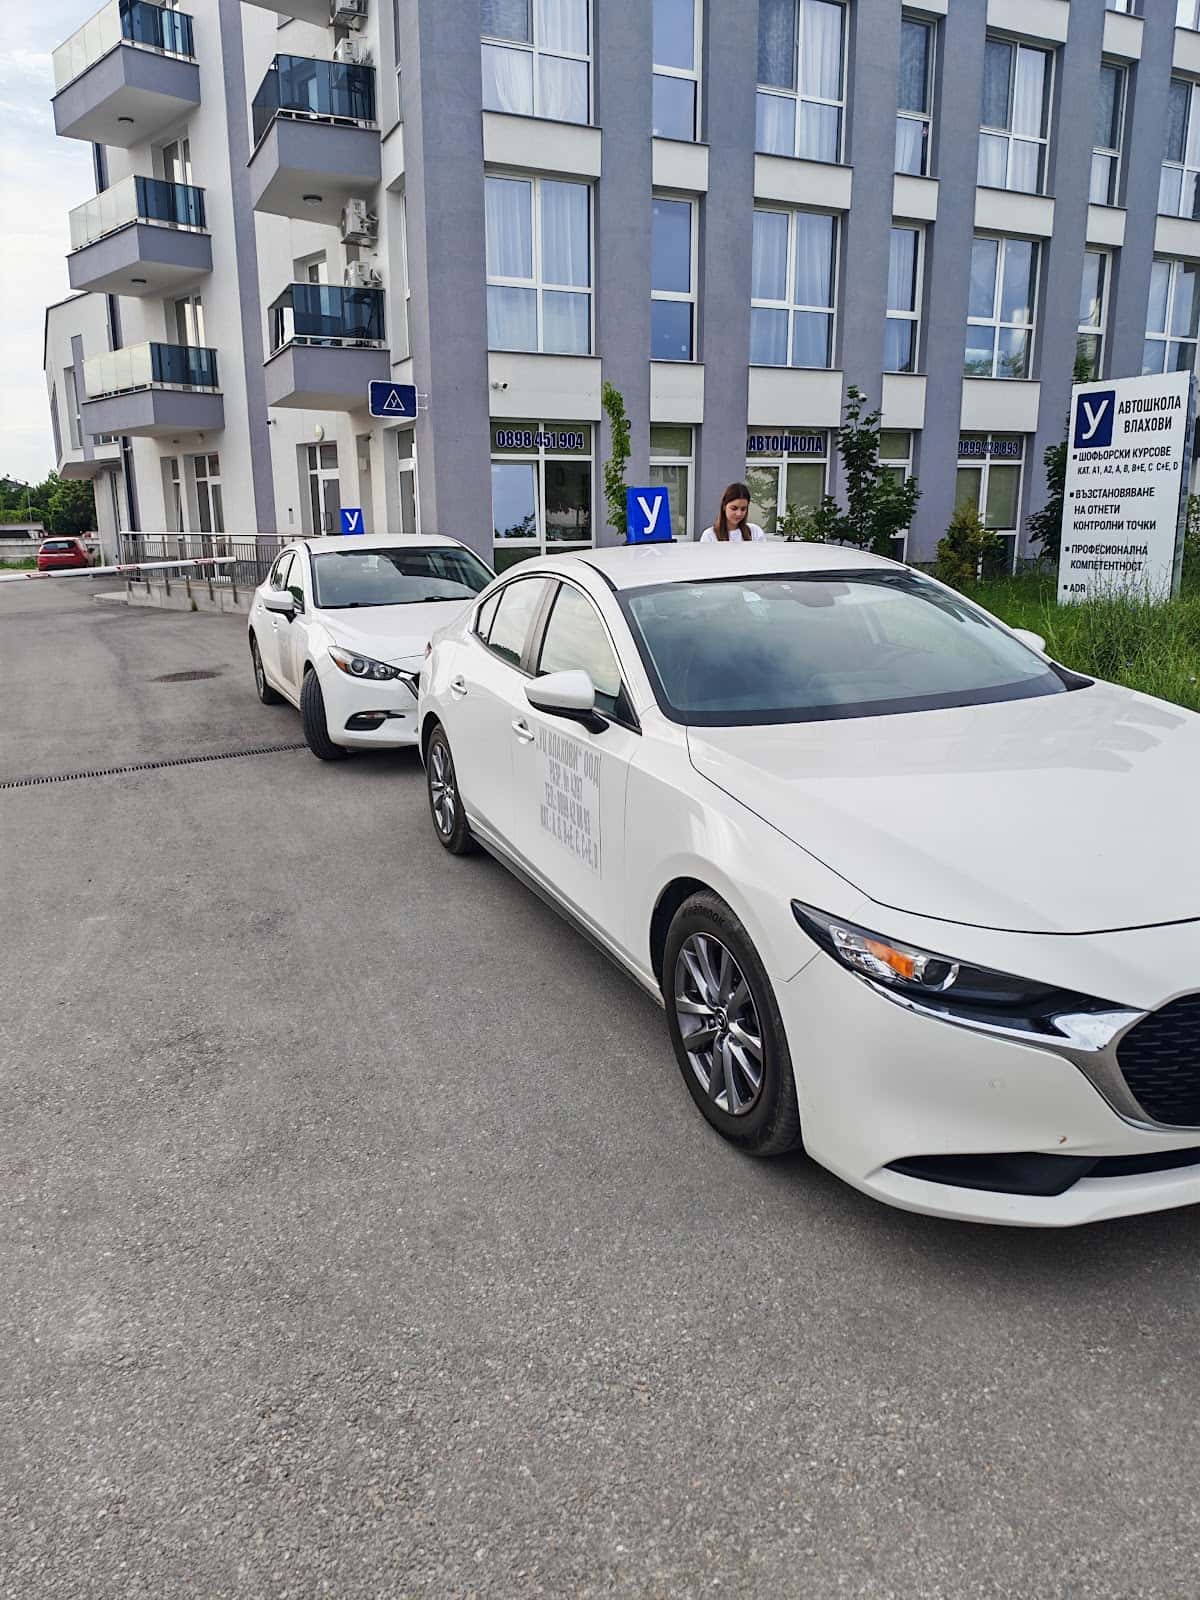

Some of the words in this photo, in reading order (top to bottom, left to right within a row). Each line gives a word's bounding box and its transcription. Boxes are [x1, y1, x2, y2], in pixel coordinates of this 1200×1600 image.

[1118, 396, 1181, 415] АВТОШКОЛА
[1082, 400, 1109, 440] У
[1124, 416, 1172, 433] ВЛАХОВИ
[496, 430, 532, 448] 0898
[534, 431, 558, 449] 451
[559, 432, 584, 449] 904
[748, 435, 823, 452] АВТОШКОЛА
[1001, 441, 1019, 455] 893
[1078, 448, 1130, 461] ШОФЬОРСКИ
[1132, 446, 1172, 459] КУРСОВЕ
[1173, 461, 1179, 470] D
[1075, 487, 1155, 499] ВЪЗСТАНОВЯВАНЕ
[637, 495, 662, 535] У
[1074, 505, 1085, 514] НА
[1088, 504, 1120, 514] ОТНЕТИ
[345, 511, 359, 531] У
[1073, 521, 1124, 530] КОНТРОЛНИ
[1126, 521, 1156, 530] ТОЧКИ
[1071, 545, 1148, 555] ПРОФЕСИОНАЛНА
[1070, 560, 1143, 571] КОМПЕТЕНТНОСТ
[1069, 584, 1086, 592] ADR
